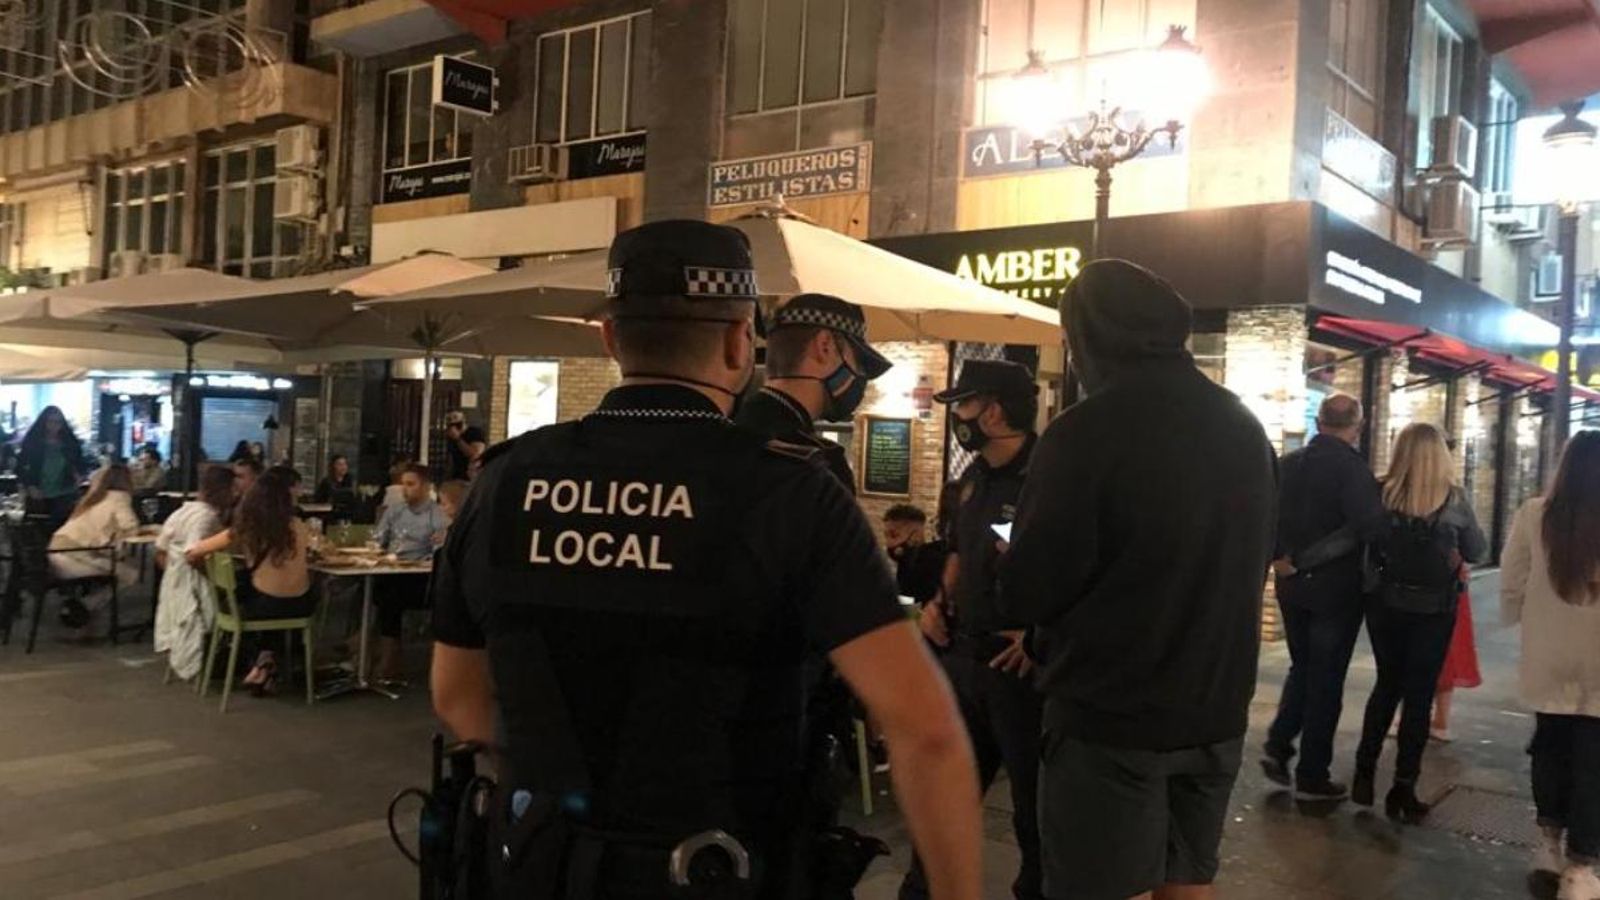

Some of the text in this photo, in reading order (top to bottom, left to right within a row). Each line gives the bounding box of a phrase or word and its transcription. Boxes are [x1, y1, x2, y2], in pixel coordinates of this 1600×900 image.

[714, 149, 856, 183] PELUQUEROS
[713, 171, 854, 204] ESTILISTAS
[955, 247, 1081, 285] AMBER
[523, 479, 694, 518] POLICIA
[529, 529, 673, 570] LOCAL
